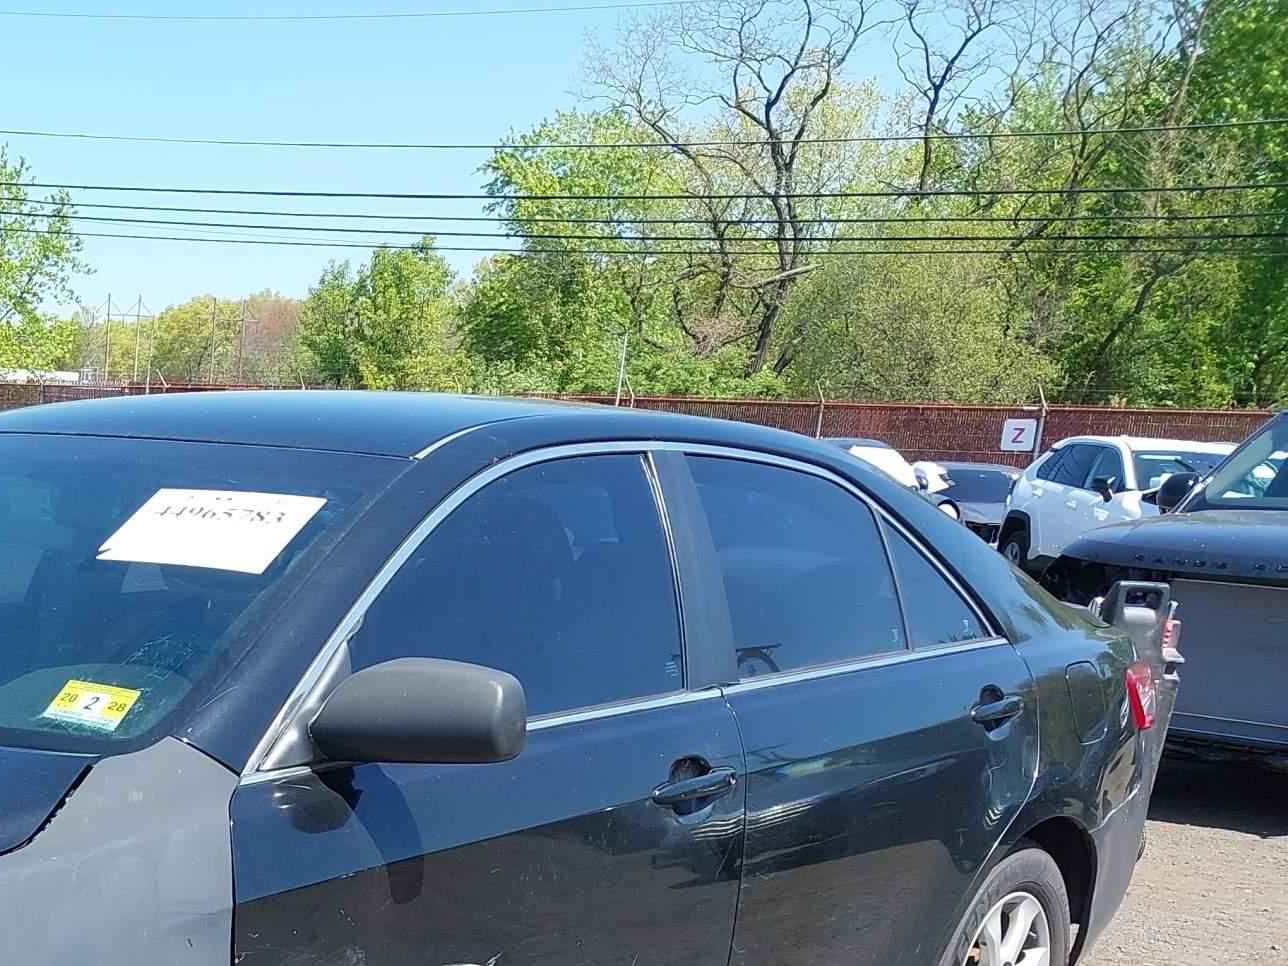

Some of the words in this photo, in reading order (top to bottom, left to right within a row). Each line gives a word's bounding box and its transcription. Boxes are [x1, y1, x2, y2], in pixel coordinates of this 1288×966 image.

[1011, 427, 1026, 444] Z
[60, 692, 79, 703] 20
[83, 696, 100, 710] 2
[107, 701, 127, 712] 28
